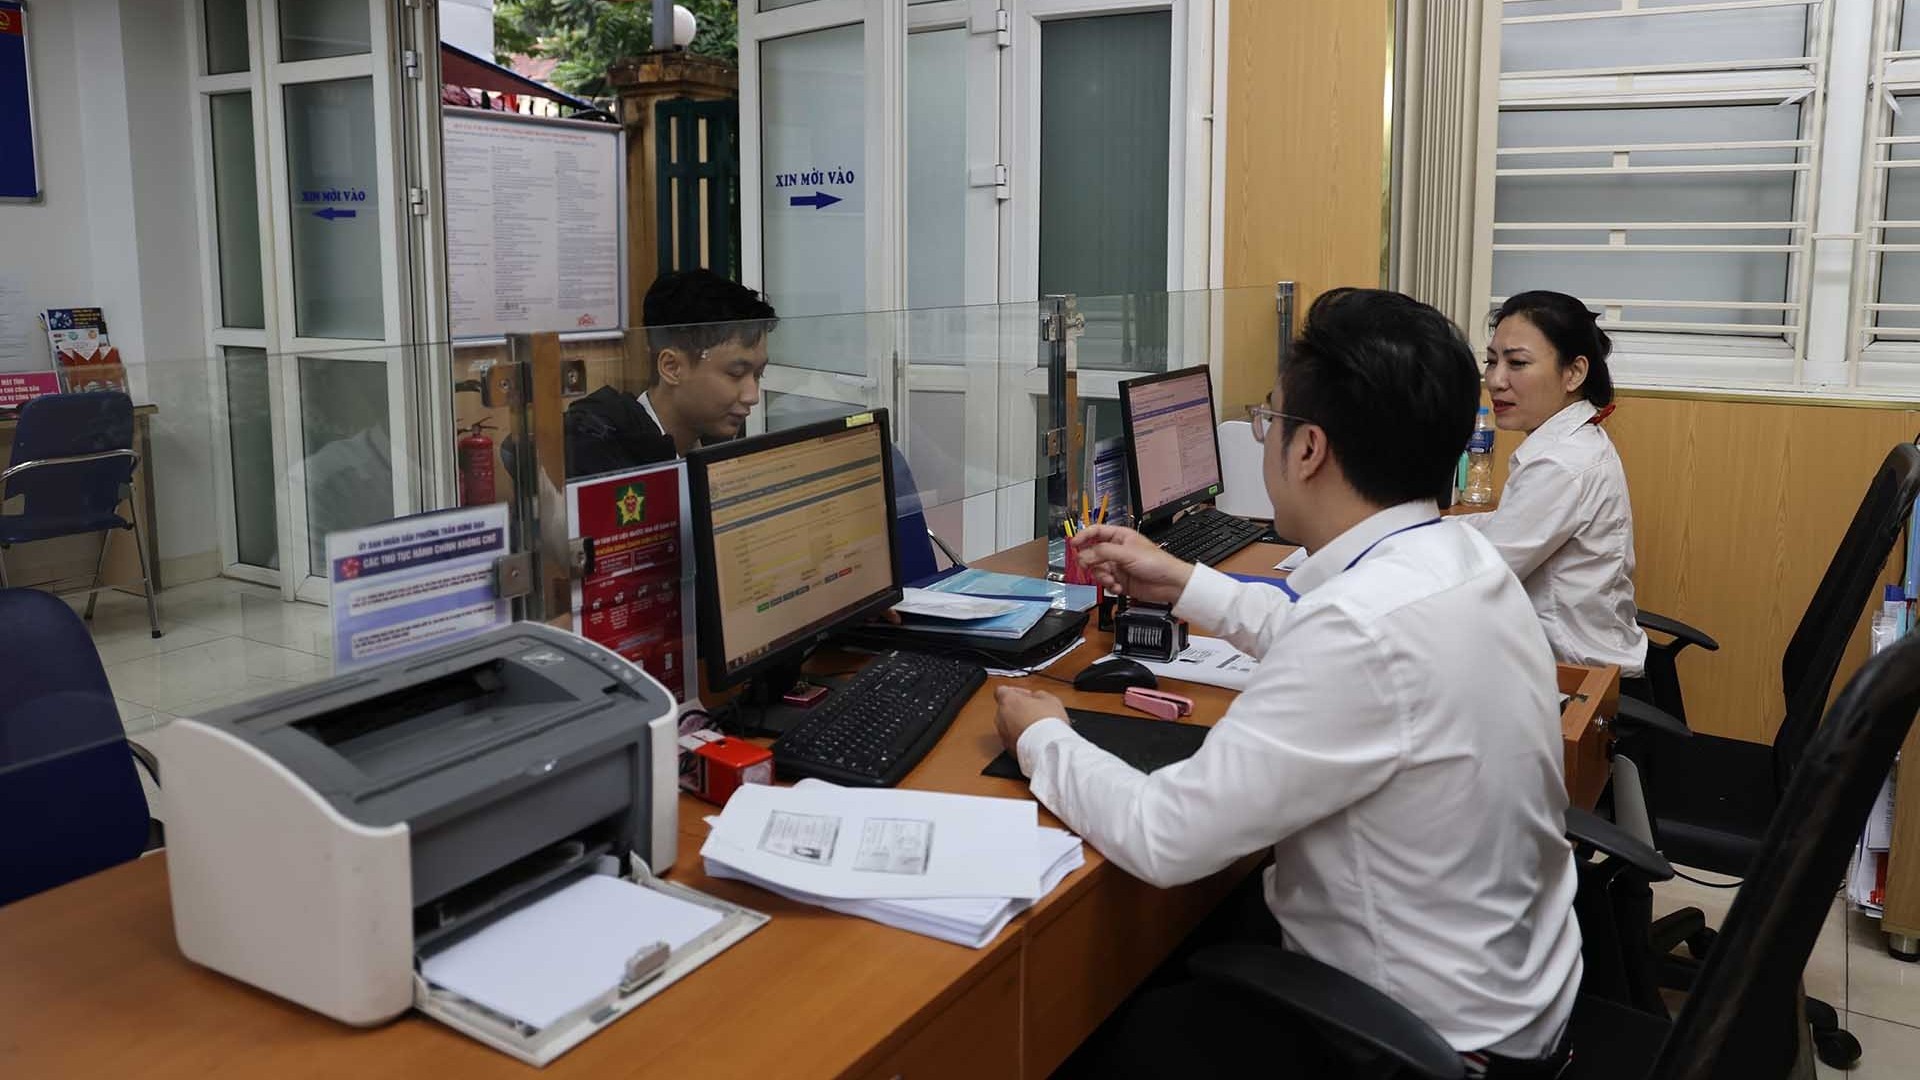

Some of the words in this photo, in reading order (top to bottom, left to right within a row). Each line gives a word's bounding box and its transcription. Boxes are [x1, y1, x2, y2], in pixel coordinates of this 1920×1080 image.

[775, 174, 797, 187] XIN
[801, 167, 824, 185] MỜI
[828, 166, 855, 184] VÀO
[344, 187, 366, 201] VÀO
